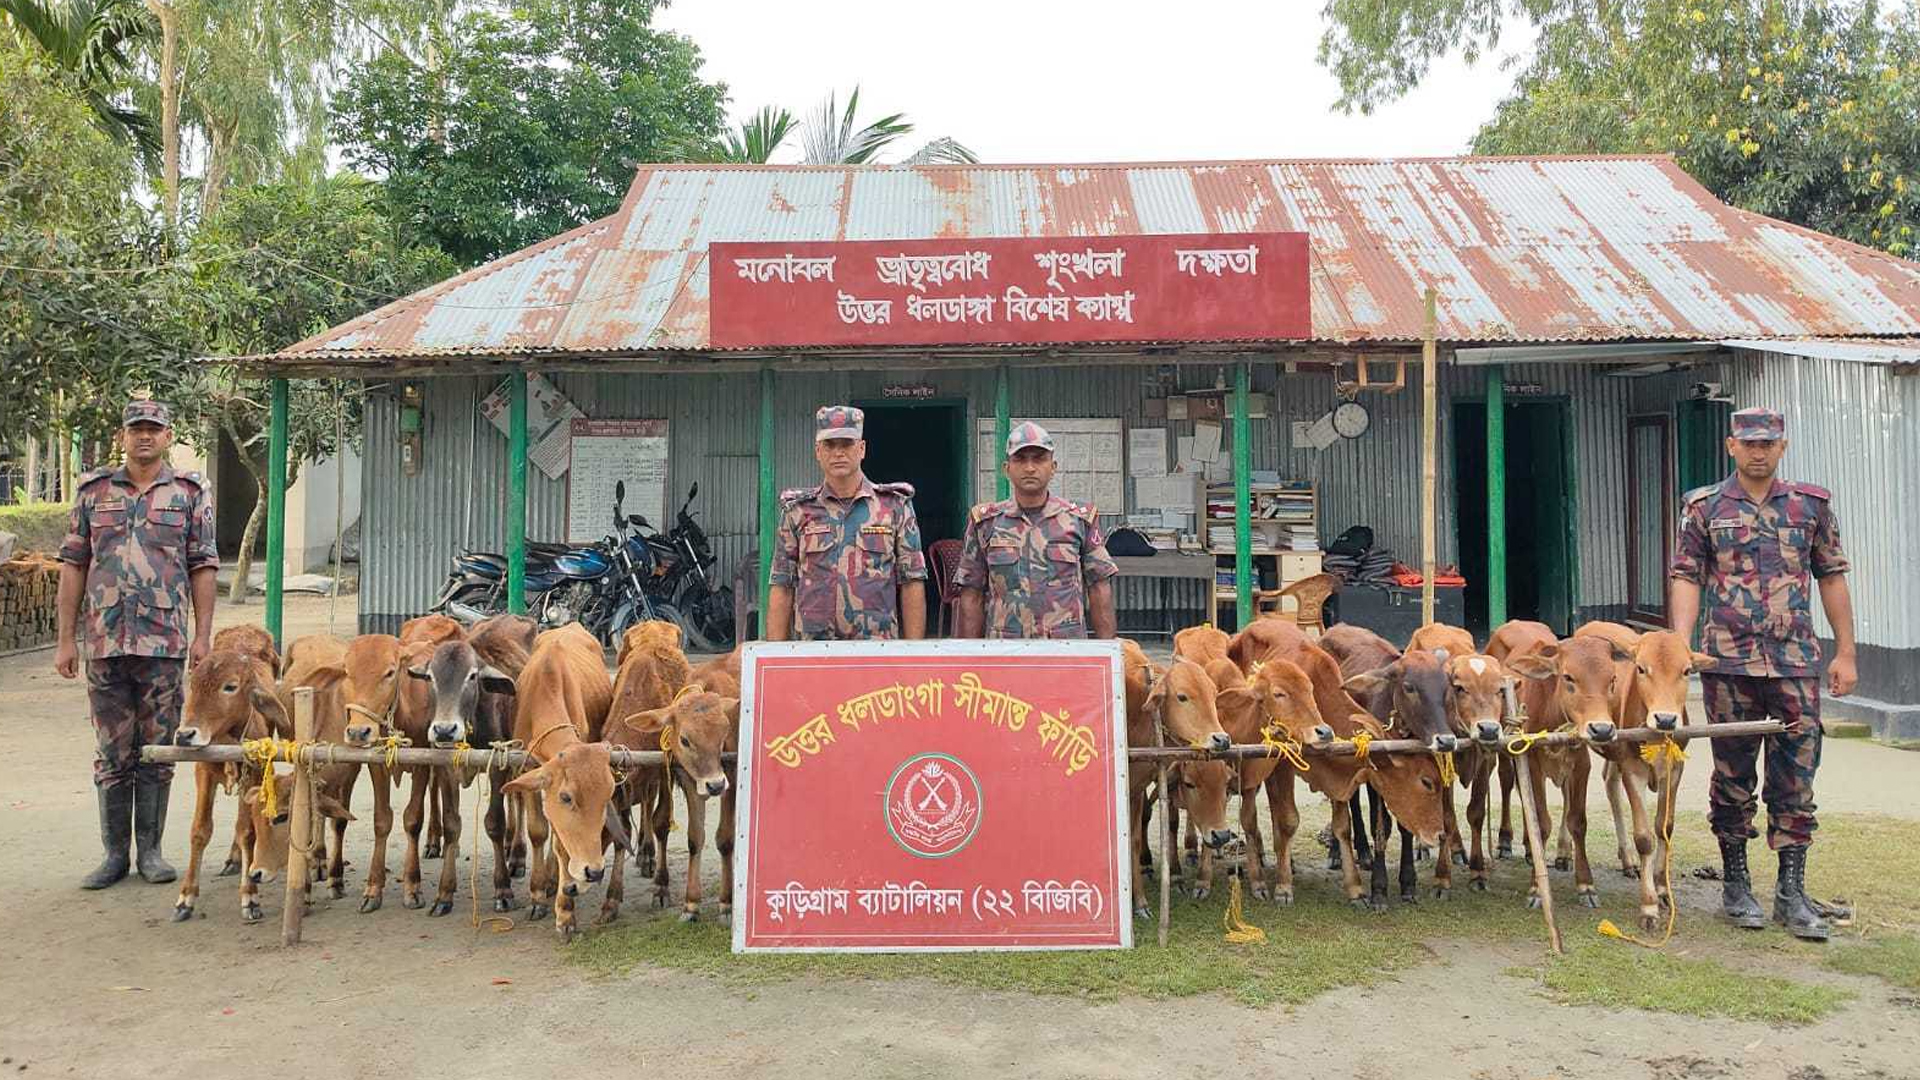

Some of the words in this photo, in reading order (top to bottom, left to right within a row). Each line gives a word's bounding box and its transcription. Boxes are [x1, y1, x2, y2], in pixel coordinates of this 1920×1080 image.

[734, 253, 836, 283] মনোবল
[876, 251, 992, 293] ভ্রাতৃত্ববোধ
[1034, 248, 1126, 293] শৃংখলা
[1175, 244, 1259, 277] দক্ষতা
[837, 290, 893, 325] উত্তর
[906, 294, 997, 324] ধলডাঙ্গা
[1003, 286, 1071, 322] বিশেষ
[1073, 290, 1135, 323] ক্যাম্প
[764, 713, 836, 768] উত্তর
[837, 677, 944, 732] ধলডাংগা
[951, 672, 1034, 732] সীমান্ত
[1037, 707, 1099, 777] ফাঁড়ি
[764, 881, 850, 924] কুড়িগ্রাম
[856, 880, 964, 915] ব্যাটালিয়ন
[972, 884, 1017, 921] (২২
[1021, 880, 1104, 920] বিজিবি)
